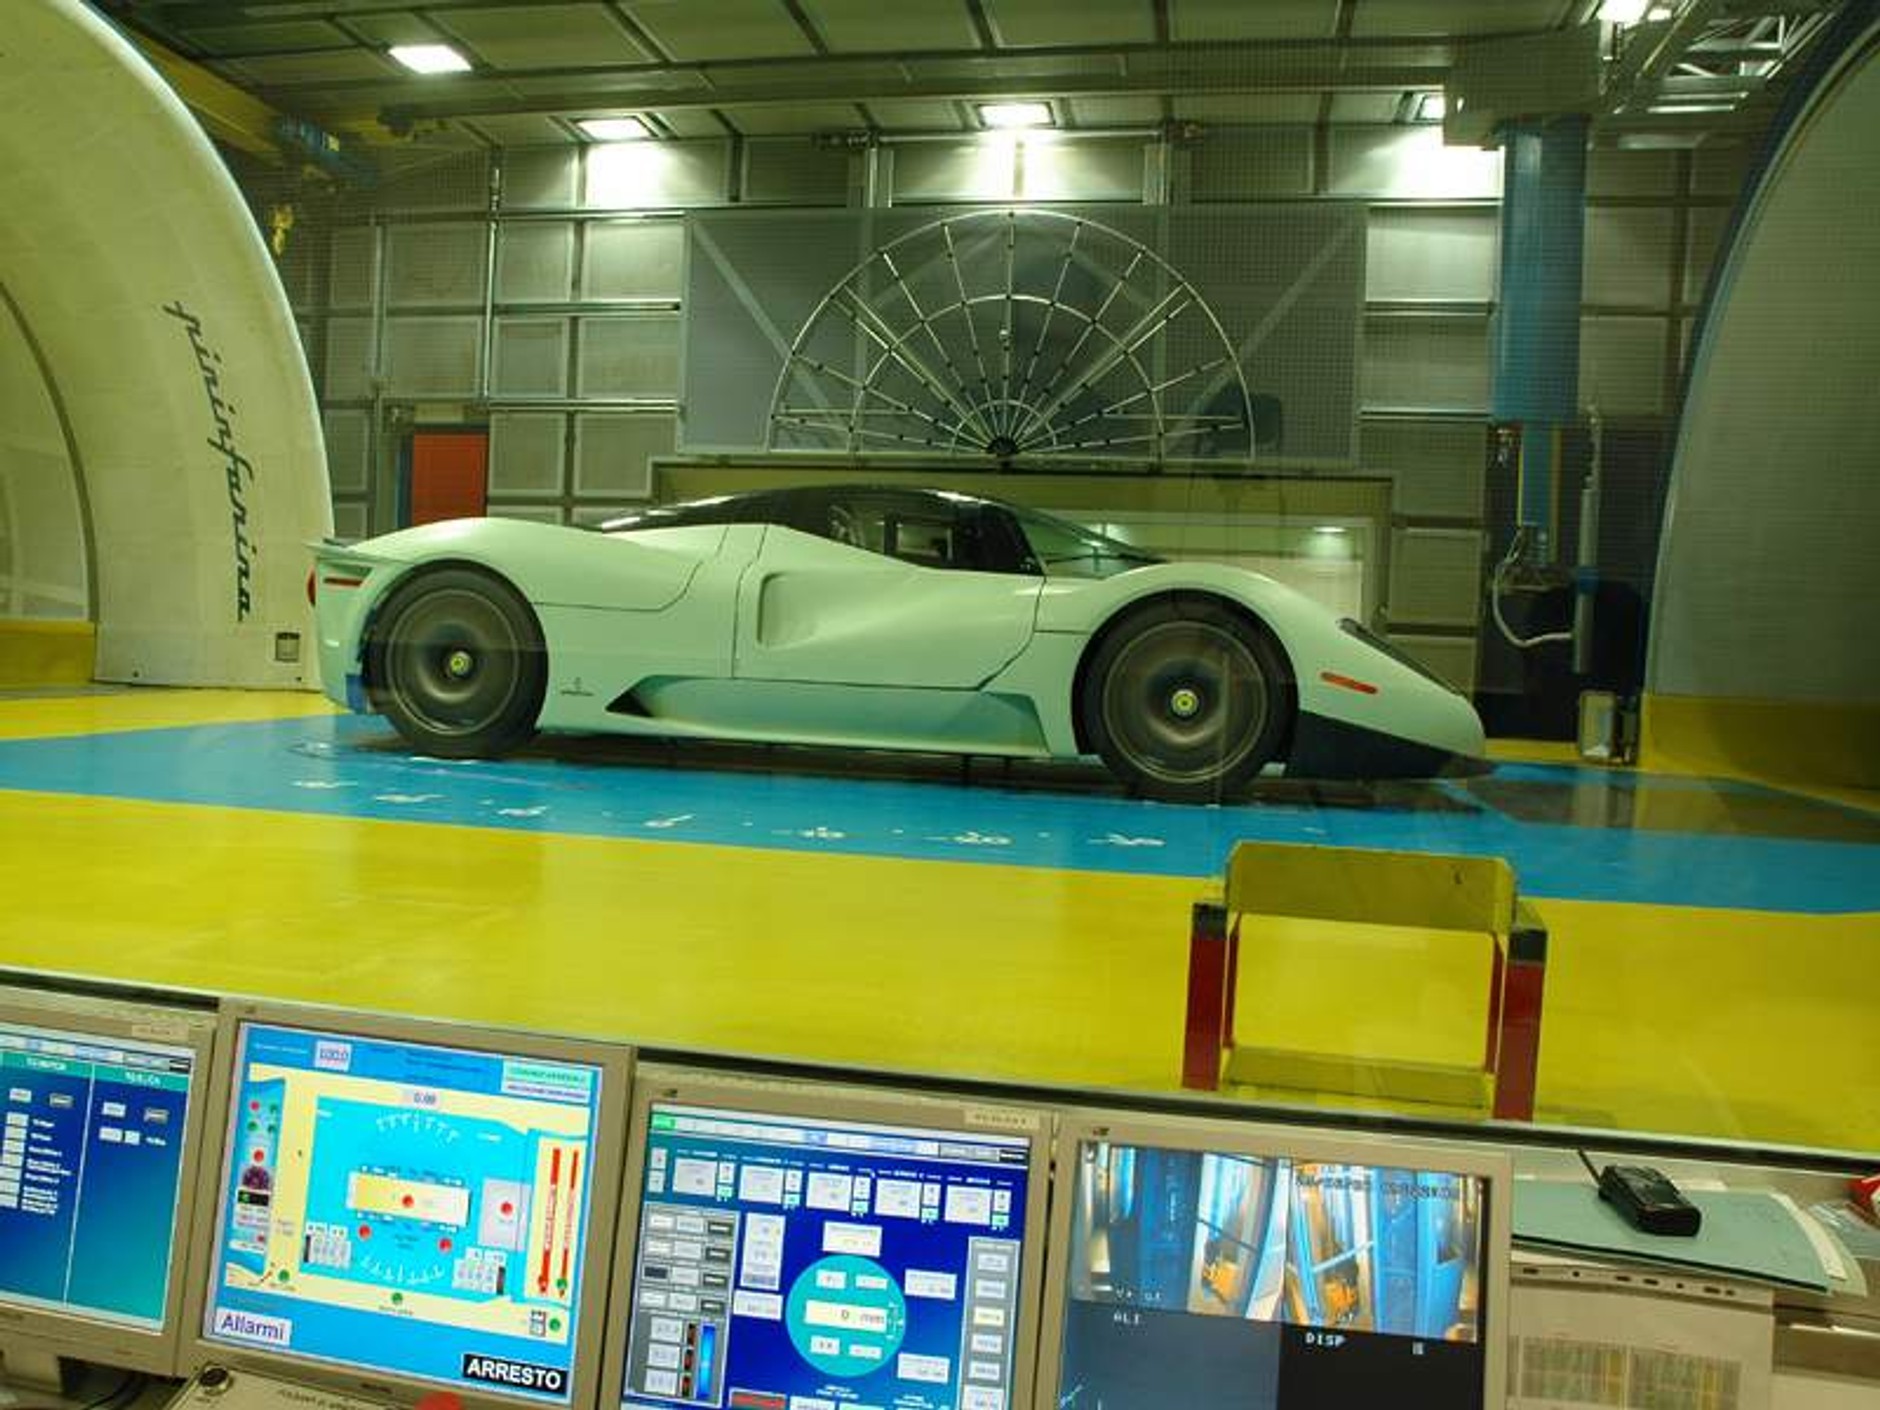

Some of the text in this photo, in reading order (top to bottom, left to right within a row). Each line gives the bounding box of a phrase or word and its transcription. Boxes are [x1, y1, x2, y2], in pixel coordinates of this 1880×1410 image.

[163, 301, 257, 623] pininfarina
[221, 1312, 285, 1341] Allarmi
[1304, 1331, 1346, 1348] DISP
[466, 1357, 562, 1390] ARRESTO
